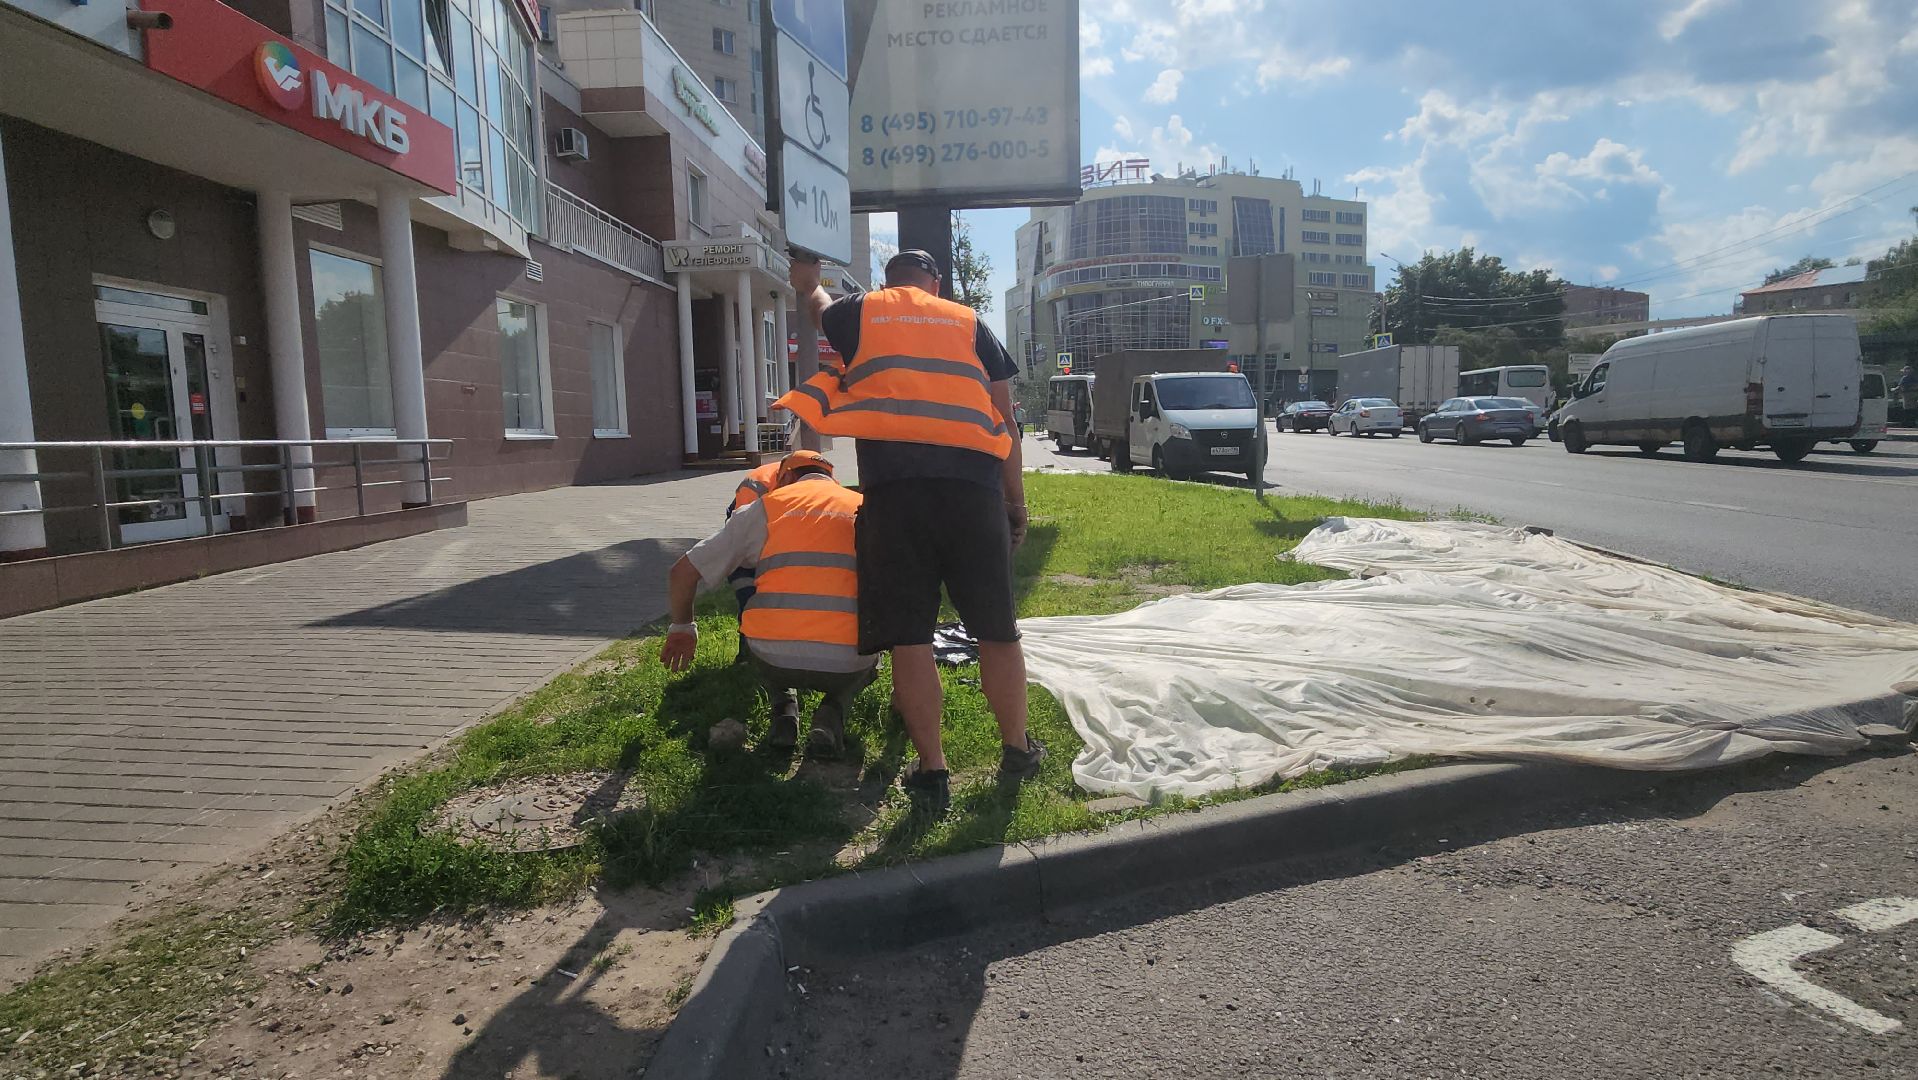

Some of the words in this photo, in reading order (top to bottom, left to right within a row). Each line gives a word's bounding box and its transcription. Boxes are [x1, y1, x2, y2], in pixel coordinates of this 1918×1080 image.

[923, 0, 1048, 19] РЕКЛАМНОЕ
[887, 29, 954, 48] МЕСТО
[959, 24, 1048, 45] СДАЕТСЯ
[310, 68, 410, 155] МКБ
[861, 115, 873, 133] 8
[881, 111, 936, 136] (495)
[944, 106, 1048, 129] 710-97-43
[862, 147, 874, 166] 8
[881, 143, 935, 169] (499)
[941, 139, 1049, 163] 276-000-5
[689, 256, 751, 266] ТЕЛЕФОНОВ
[703, 245, 743, 254] РЕМОНТ
